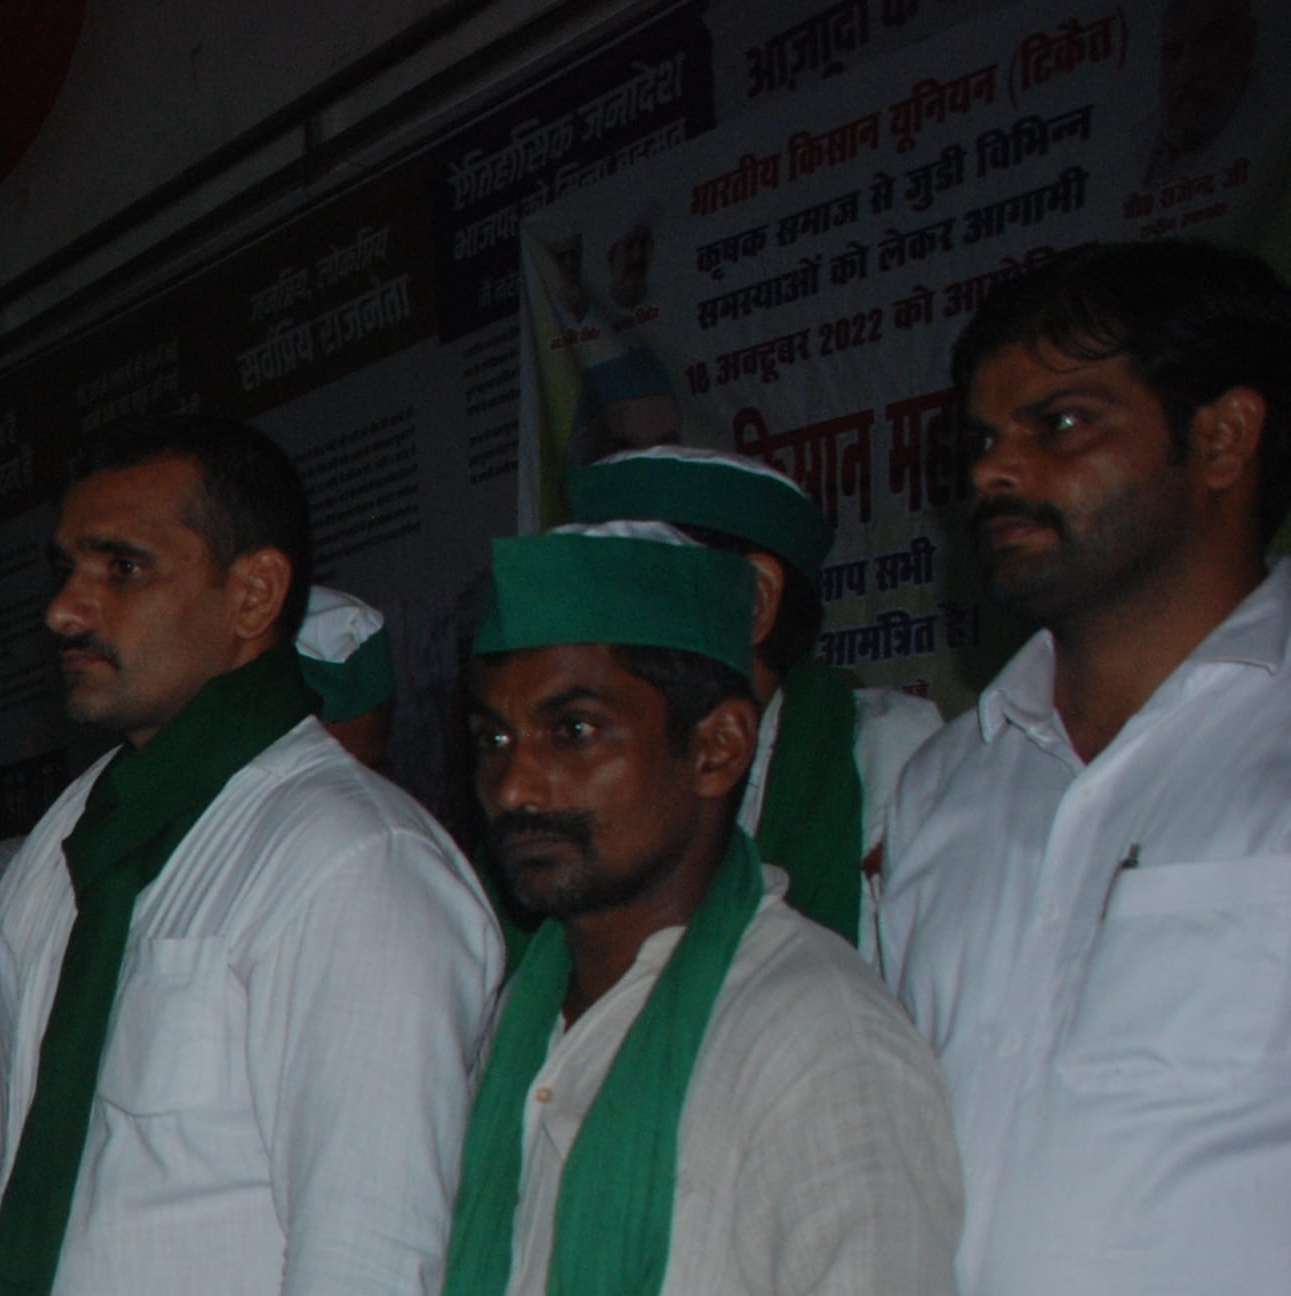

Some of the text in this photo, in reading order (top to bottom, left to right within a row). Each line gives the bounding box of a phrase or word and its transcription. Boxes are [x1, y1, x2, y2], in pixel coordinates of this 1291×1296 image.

[446, 111, 574, 211] ऐतिहासिक
[690, 10, 1128, 216] भारतीय किसान यूनियन (टिकैत)
[696, 224, 769, 280] कृषक
[776, 190, 861, 247] समाज
[870, 171, 895, 214] से
[976, 103, 1095, 177] विभिन्न
[696, 253, 822, 330] समस्याओं
[829, 241, 868, 285] को
[877, 217, 956, 272] लेकर
[962, 164, 1089, 245] आगामी
[314, 272, 410, 356] राजनेता
[685, 360, 710, 395] 18
[715, 328, 811, 384] अक्टूबर
[819, 308, 883, 357] 2022
[891, 285, 934, 329] को
[874, 536, 937, 591] सभी
